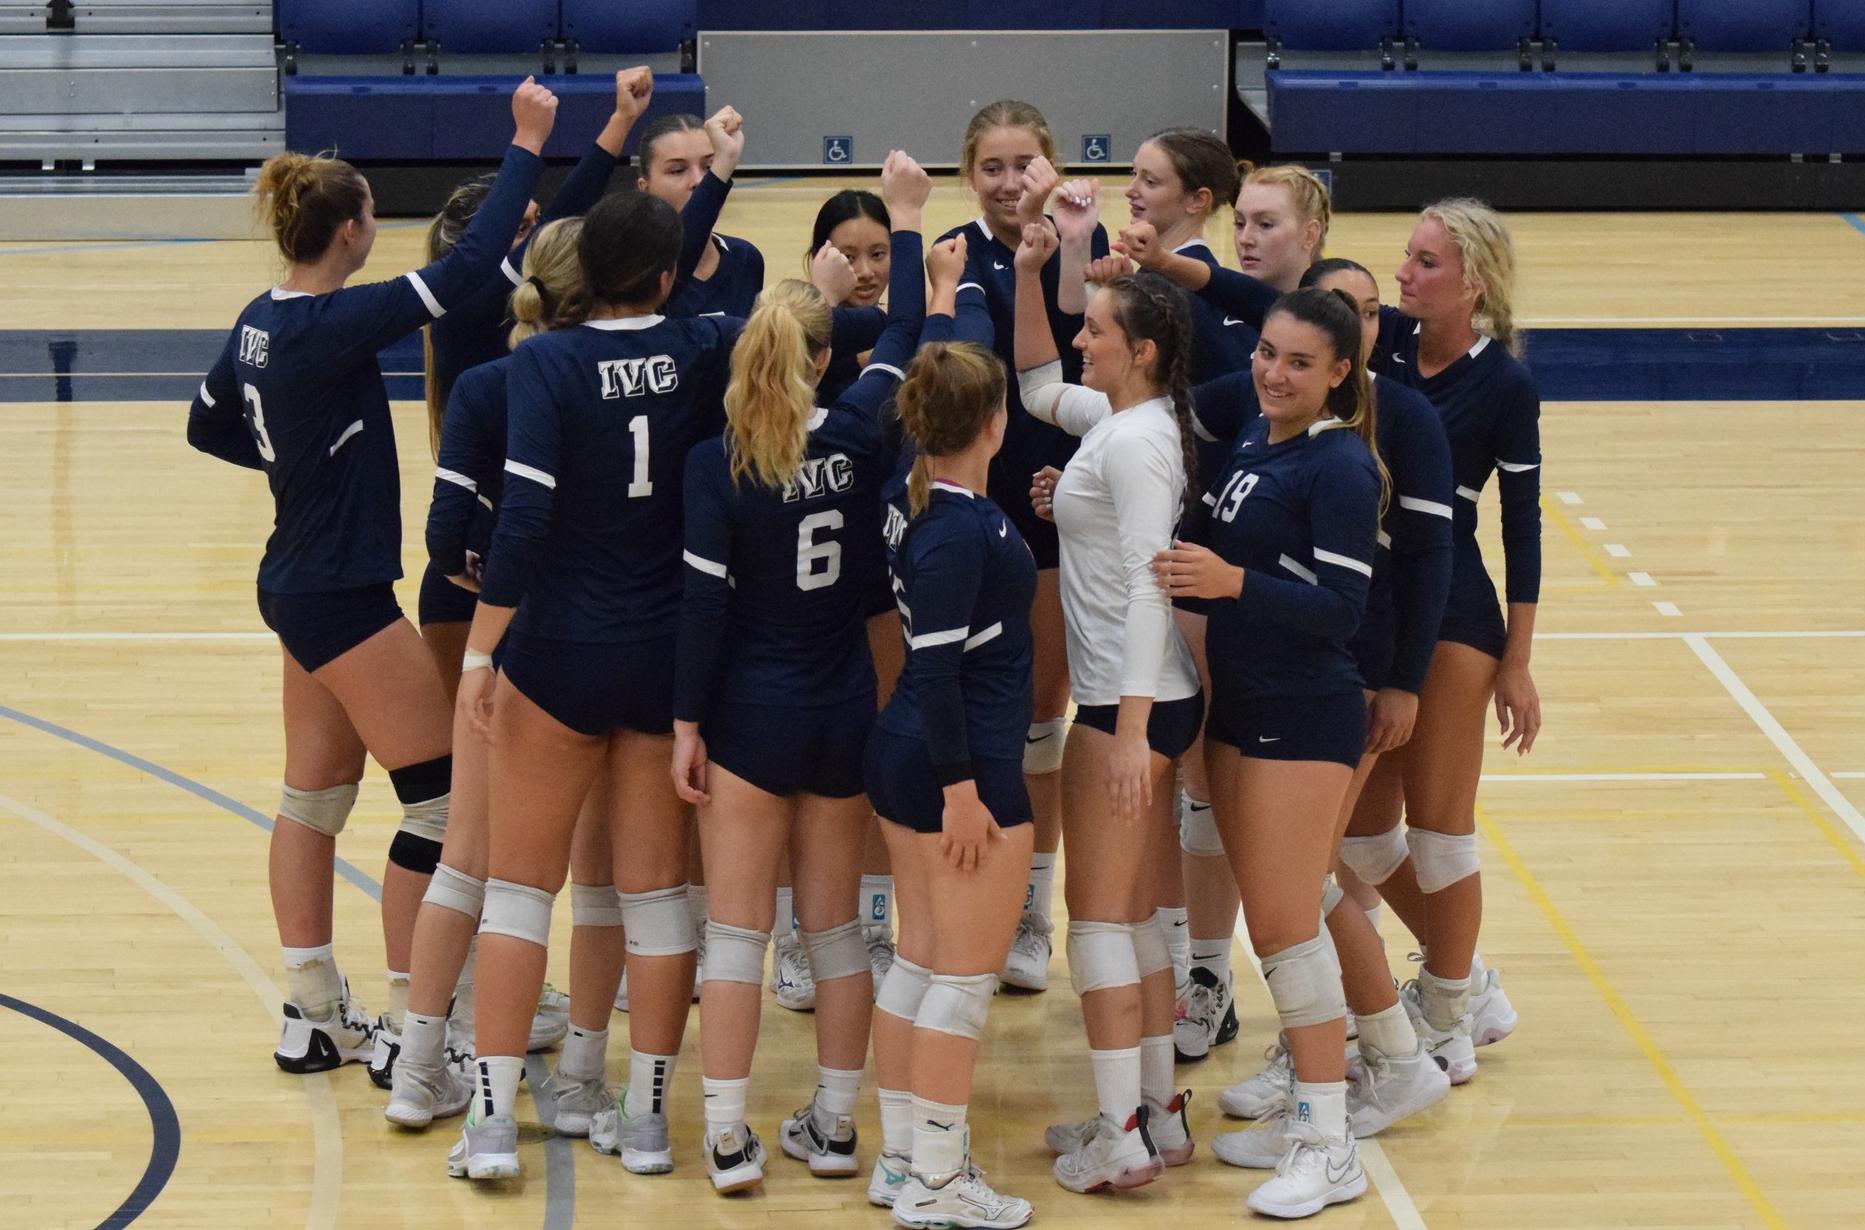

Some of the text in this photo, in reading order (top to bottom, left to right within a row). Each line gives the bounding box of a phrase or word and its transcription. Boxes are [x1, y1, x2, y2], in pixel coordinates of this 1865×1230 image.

[239, 324, 269, 369] IVC
[598, 354, 679, 400] IVC
[627, 415, 653, 498] 1
[1212, 470, 1260, 523] 19
[797, 508, 844, 592] 6
